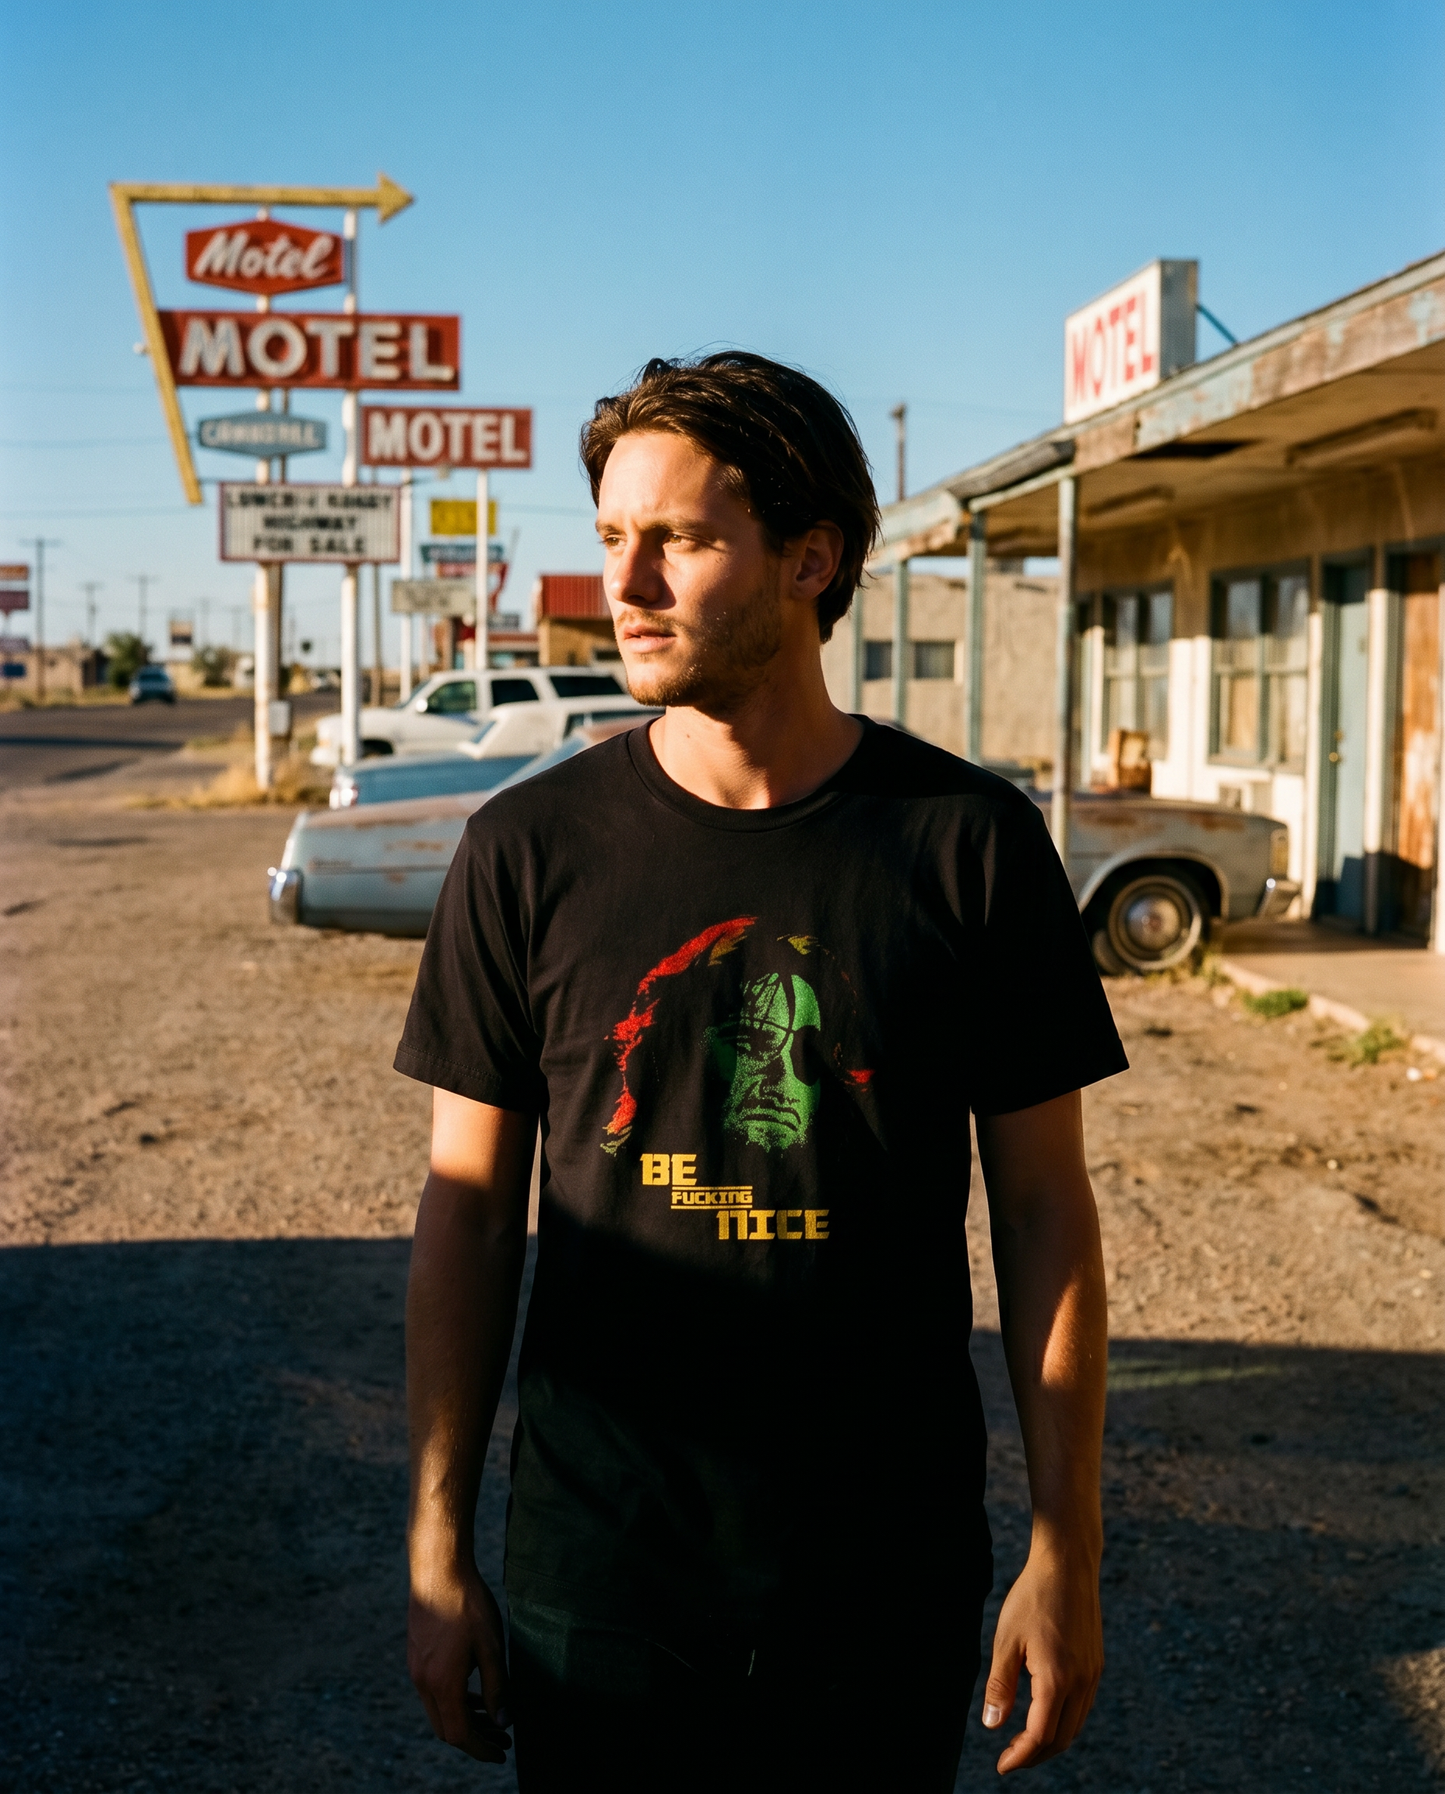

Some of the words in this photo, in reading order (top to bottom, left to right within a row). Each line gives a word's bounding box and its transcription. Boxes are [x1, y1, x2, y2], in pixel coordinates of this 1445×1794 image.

[194, 229, 334, 279] Motel
[179, 317, 454, 380] MOTEL
[1066, 290, 1158, 406] MOTEL
[368, 410, 528, 462] MOTEL
[252, 535, 294, 552] FOR
[309, 536, 367, 553] SALE
[640, 1153, 698, 1186] BE
[671, 1190, 753, 1205] FUCKING
[716, 1209, 830, 1240] NICE
